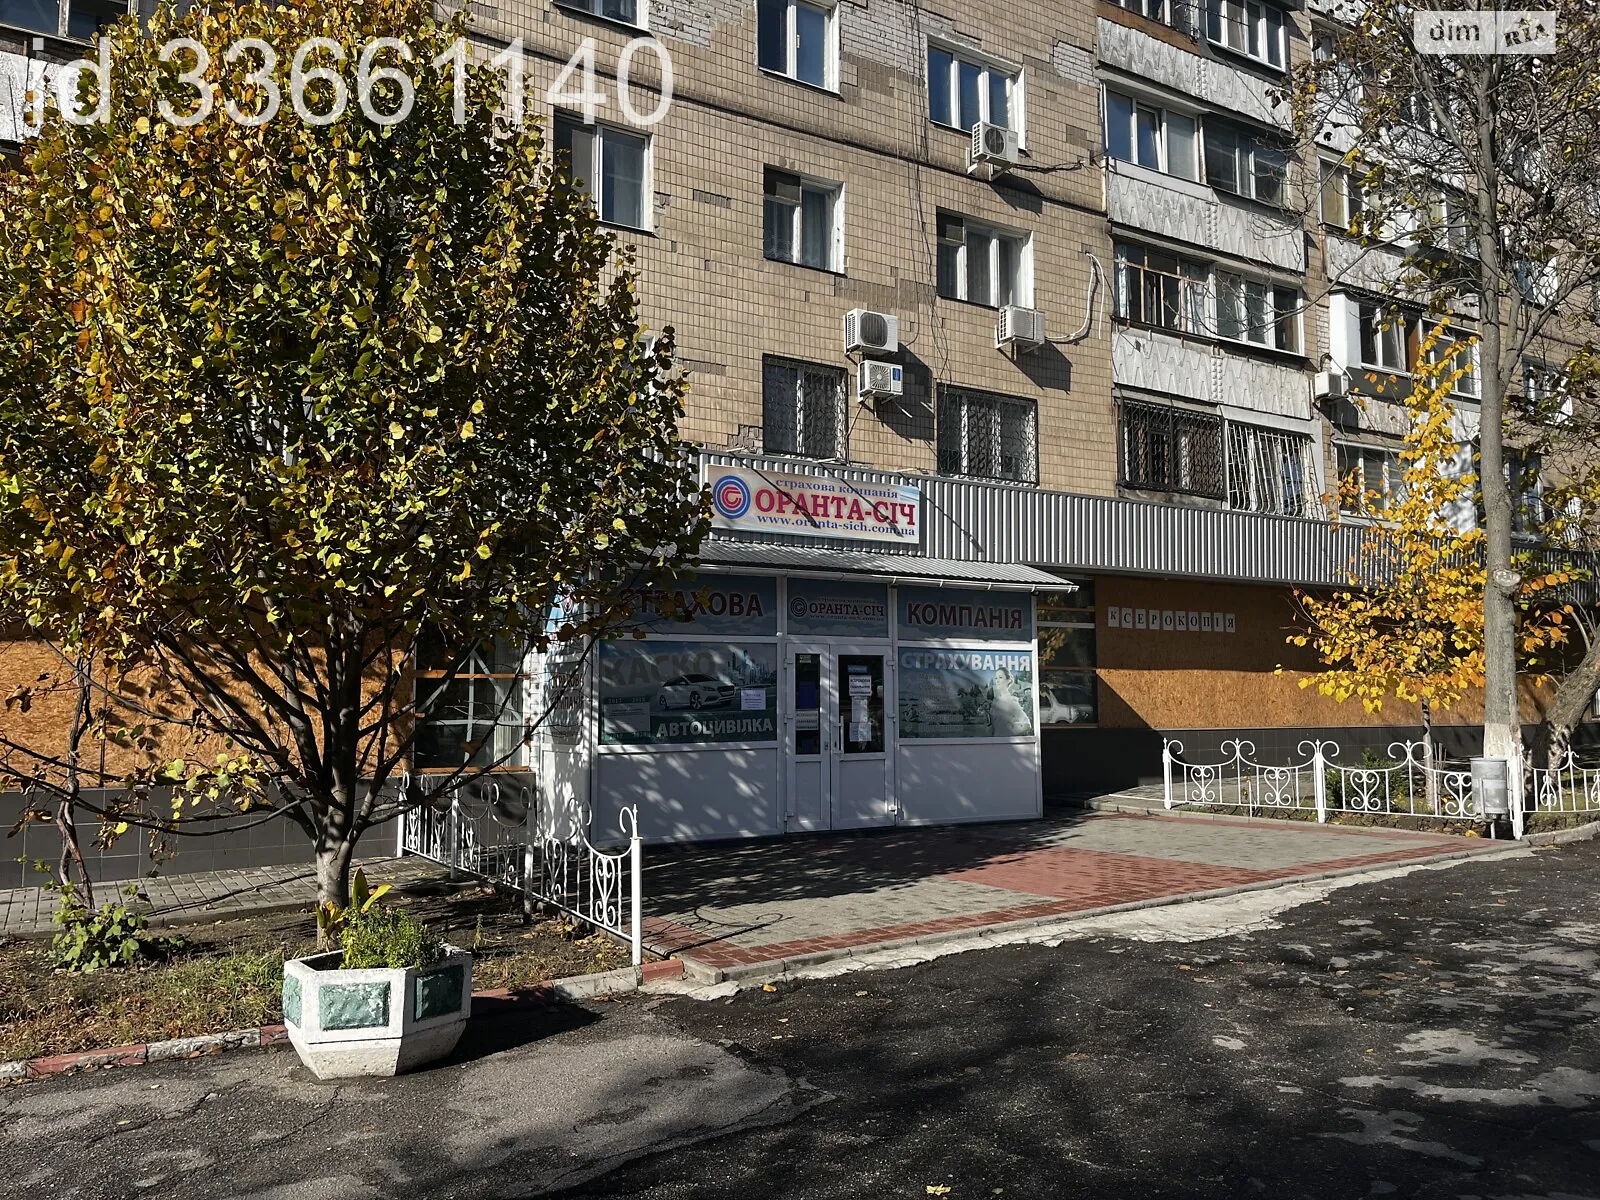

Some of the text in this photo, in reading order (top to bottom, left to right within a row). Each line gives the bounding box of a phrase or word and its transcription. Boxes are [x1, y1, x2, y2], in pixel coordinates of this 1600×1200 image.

[775, 479, 898, 499] страхова компанія
[755, 489, 916, 526] ОРАНТА-СІЧ
[809, 602, 884, 617] ОРАНТА-СІЧ
[907, 603, 1022, 629] КОМПАНІЯ
[1110, 611, 1234, 628] КСЕРОКОПІЯ
[603, 651, 716, 687] КАСКО
[901, 651, 1031, 672] СТРАХУВАННЯ
[656, 717, 774, 738] АВТОЦИВІЛКА
